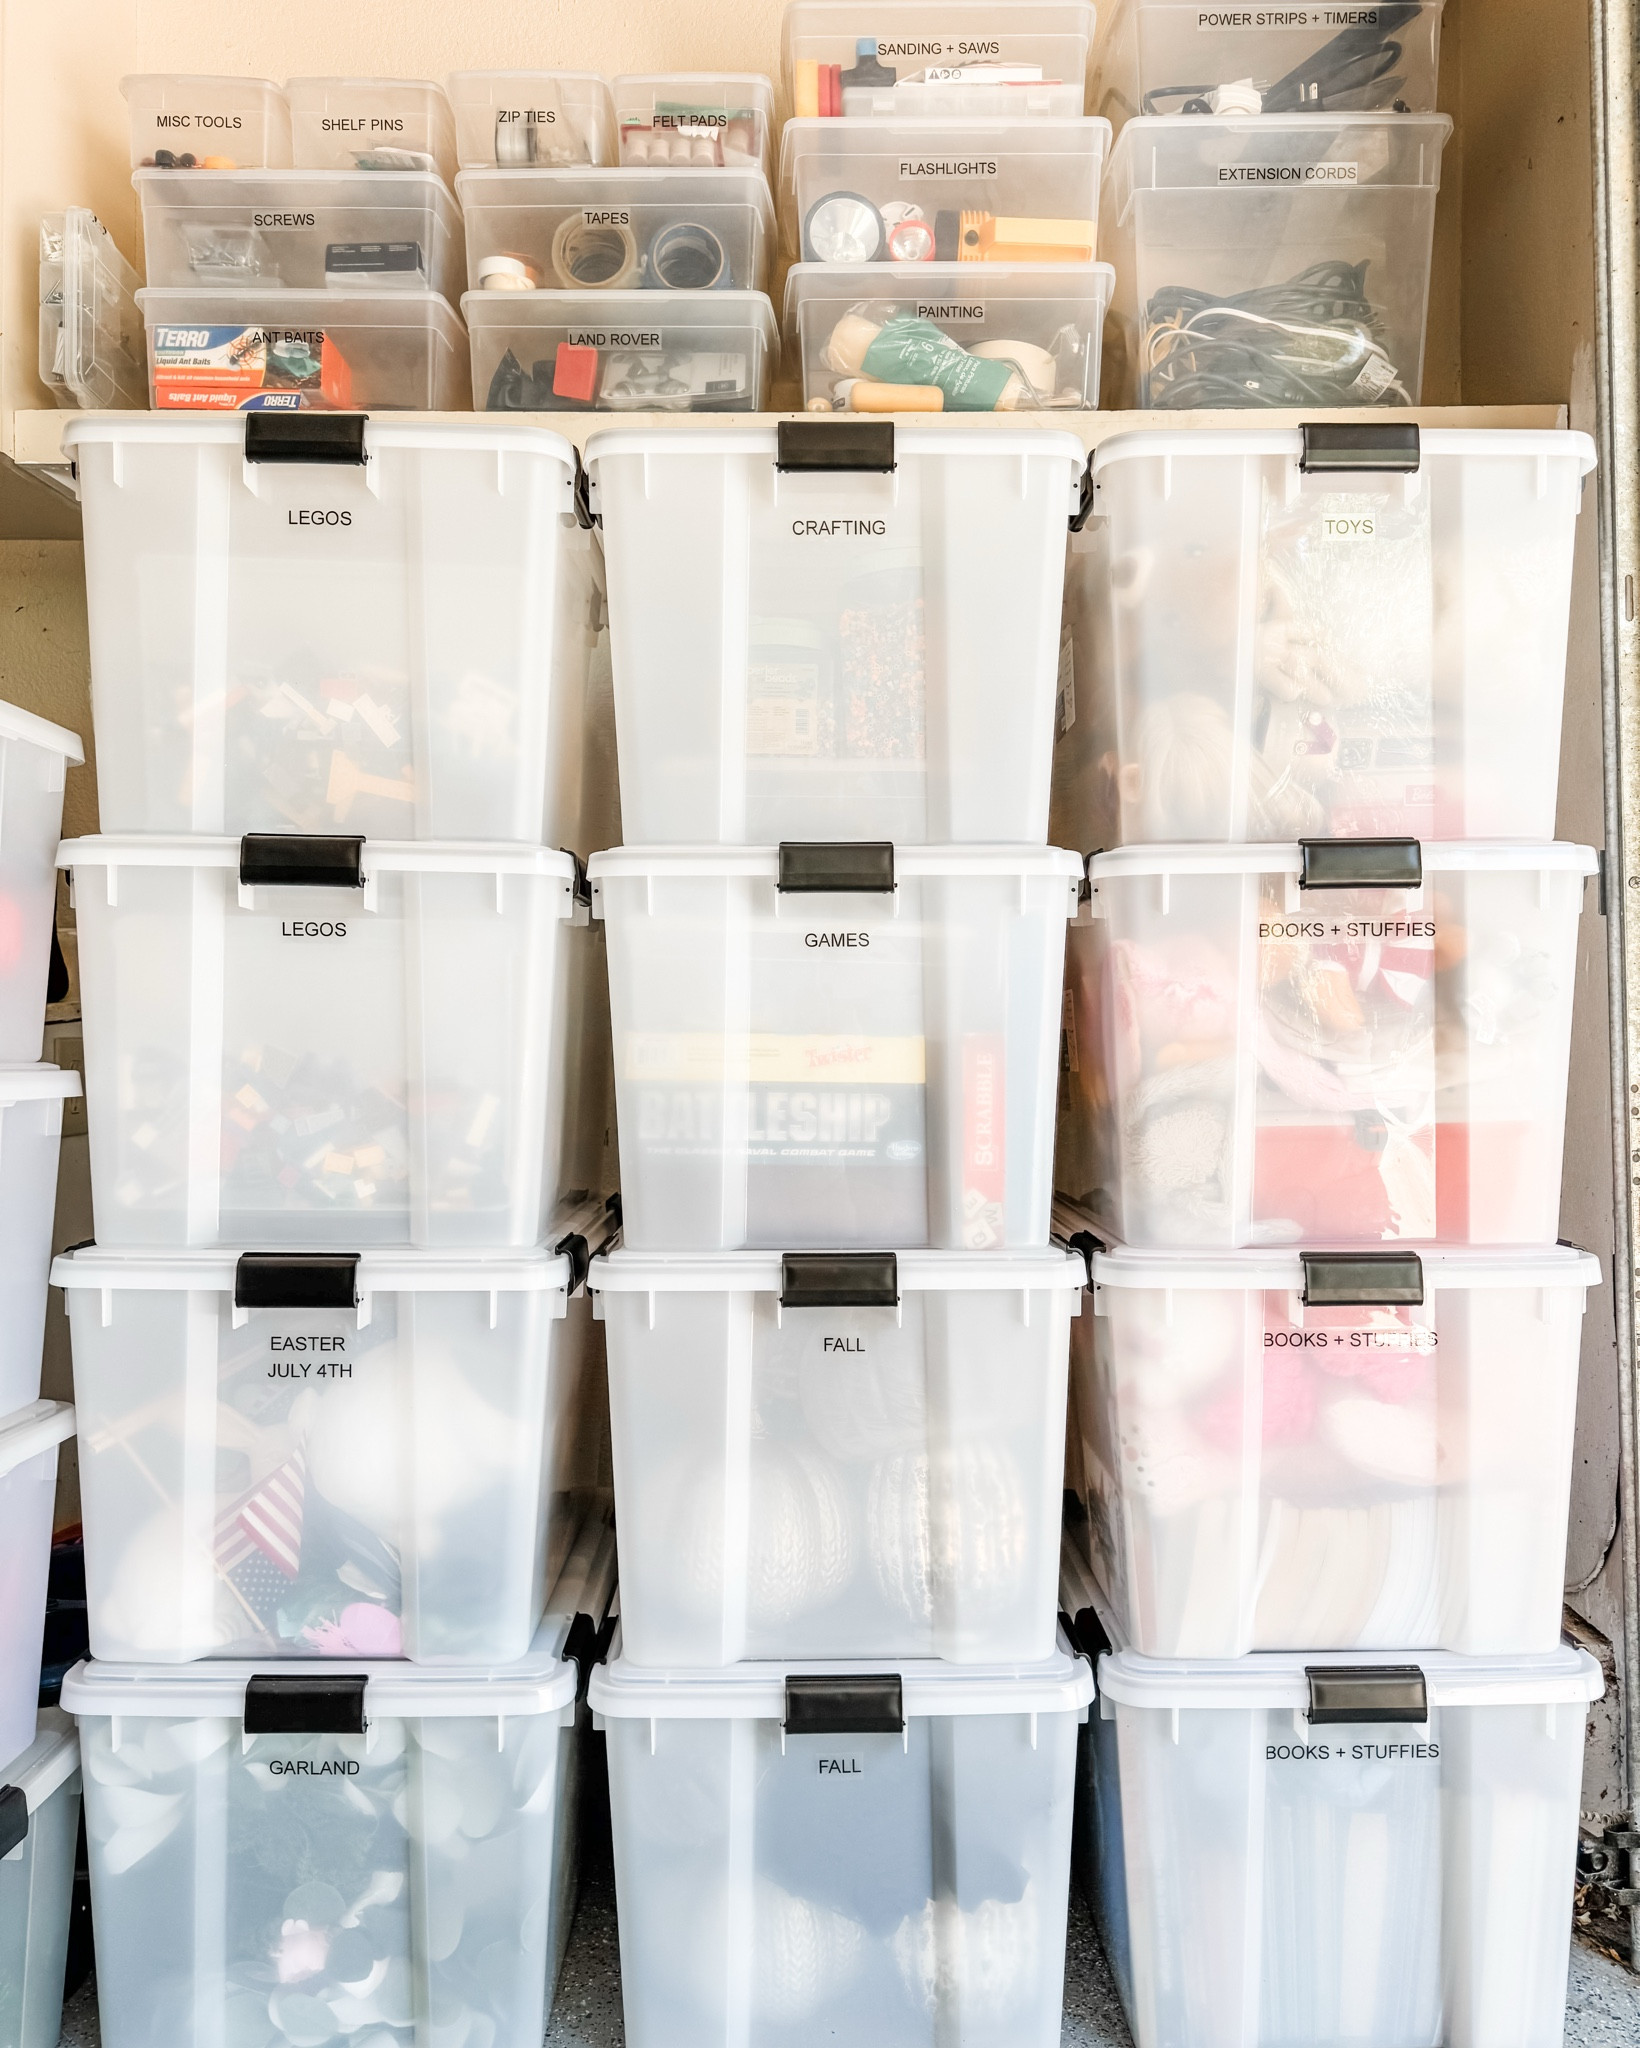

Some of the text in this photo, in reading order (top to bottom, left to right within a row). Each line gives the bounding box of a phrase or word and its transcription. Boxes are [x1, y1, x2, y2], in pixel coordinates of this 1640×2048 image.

[1198, 13, 1252, 27] POWER
[1255, 12, 1308, 26] STRIPS
[1323, 11, 1377, 25] TIMERS
[877, 42, 942, 56] SANDING
[958, 41, 1000, 55] SAWS
[156, 115, 242, 129] MISC TOOLS
[498, 110, 556, 124] ZIP TIES
[652, 114, 727, 128] FELT PADS
[321, 118, 404, 132] SHELF PINS
[900, 161, 997, 176] FLASHLIGHTS
[1219, 167, 1357, 181] EXTENSION CORDS
[253, 213, 315, 227] SCREWS
[583, 212, 629, 225] TAPES
[918, 305, 984, 318] PAINTING
[156, 327, 211, 348] TERRO
[252, 331, 325, 344] ANT BAITS
[569, 333, 660, 346] LAND ROVER
[156, 357, 212, 366] Liquid Ant Baits
[168, 392, 237, 403] Liquid Ant Baits
[263, 395, 298, 408] TERRO
[288, 510, 352, 527] LEGOS
[792, 519, 886, 536] CRAFTING
[1324, 519, 1374, 535] TOYS
[282, 921, 347, 937] LEGOS
[1258, 922, 1325, 938] BOOKS
[1346, 921, 1436, 937] STUFFIES
[804, 932, 870, 948] GAMES
[805, 1044, 872, 1068] Twister
[638, 1090, 892, 1142] BATLESHIP
[974, 1053, 994, 1166] SCRABBLE
[780, 1149, 836, 1157] COMBAT
[838, 1149, 876, 1157] GAME
[270, 1336, 346, 1352] EASTER
[823, 1337, 866, 1352] FALL
[1263, 1332, 1328, 1348] BOOKS
[1349, 1331, 1439, 1348] STUIS
[267, 1363, 352, 1379] JULY 4TH
[1266, 1745, 1330, 1760] BOOKS
[1351, 1743, 1440, 1760] STUFFIES
[269, 1760, 360, 1776] GARLAND
[818, 1758, 862, 1775] FALL
